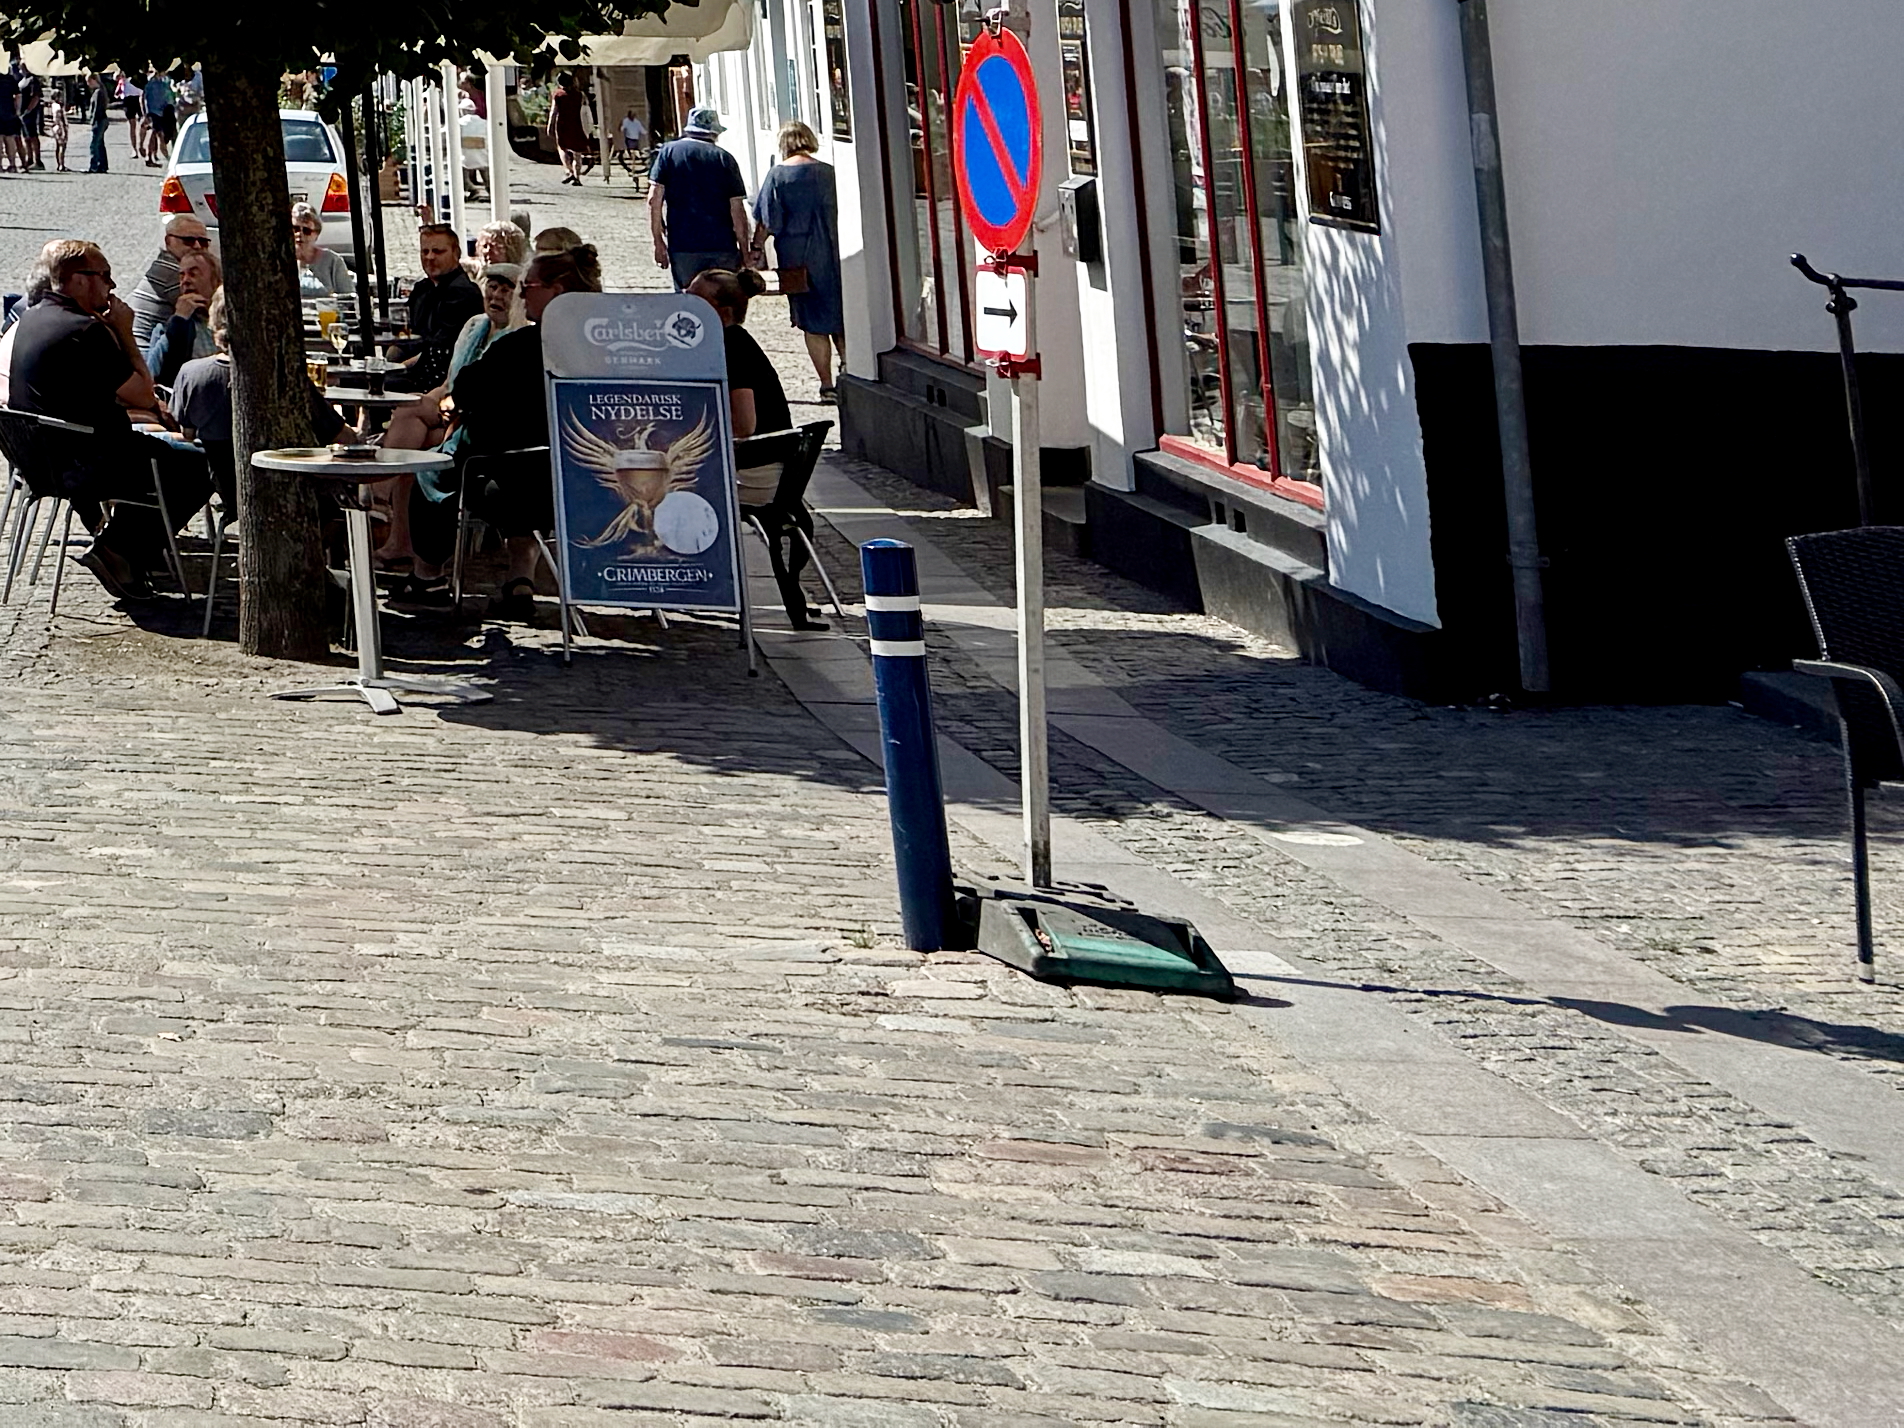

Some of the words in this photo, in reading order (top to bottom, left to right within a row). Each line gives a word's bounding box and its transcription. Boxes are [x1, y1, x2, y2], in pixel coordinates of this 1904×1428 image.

[584, 317, 668, 352] Carlsber
[589, 394, 681, 404] LEGENDARISK
[592, 405, 683, 420] NYDELSE
[603, 566, 708, 582] GRIMBERGEN
